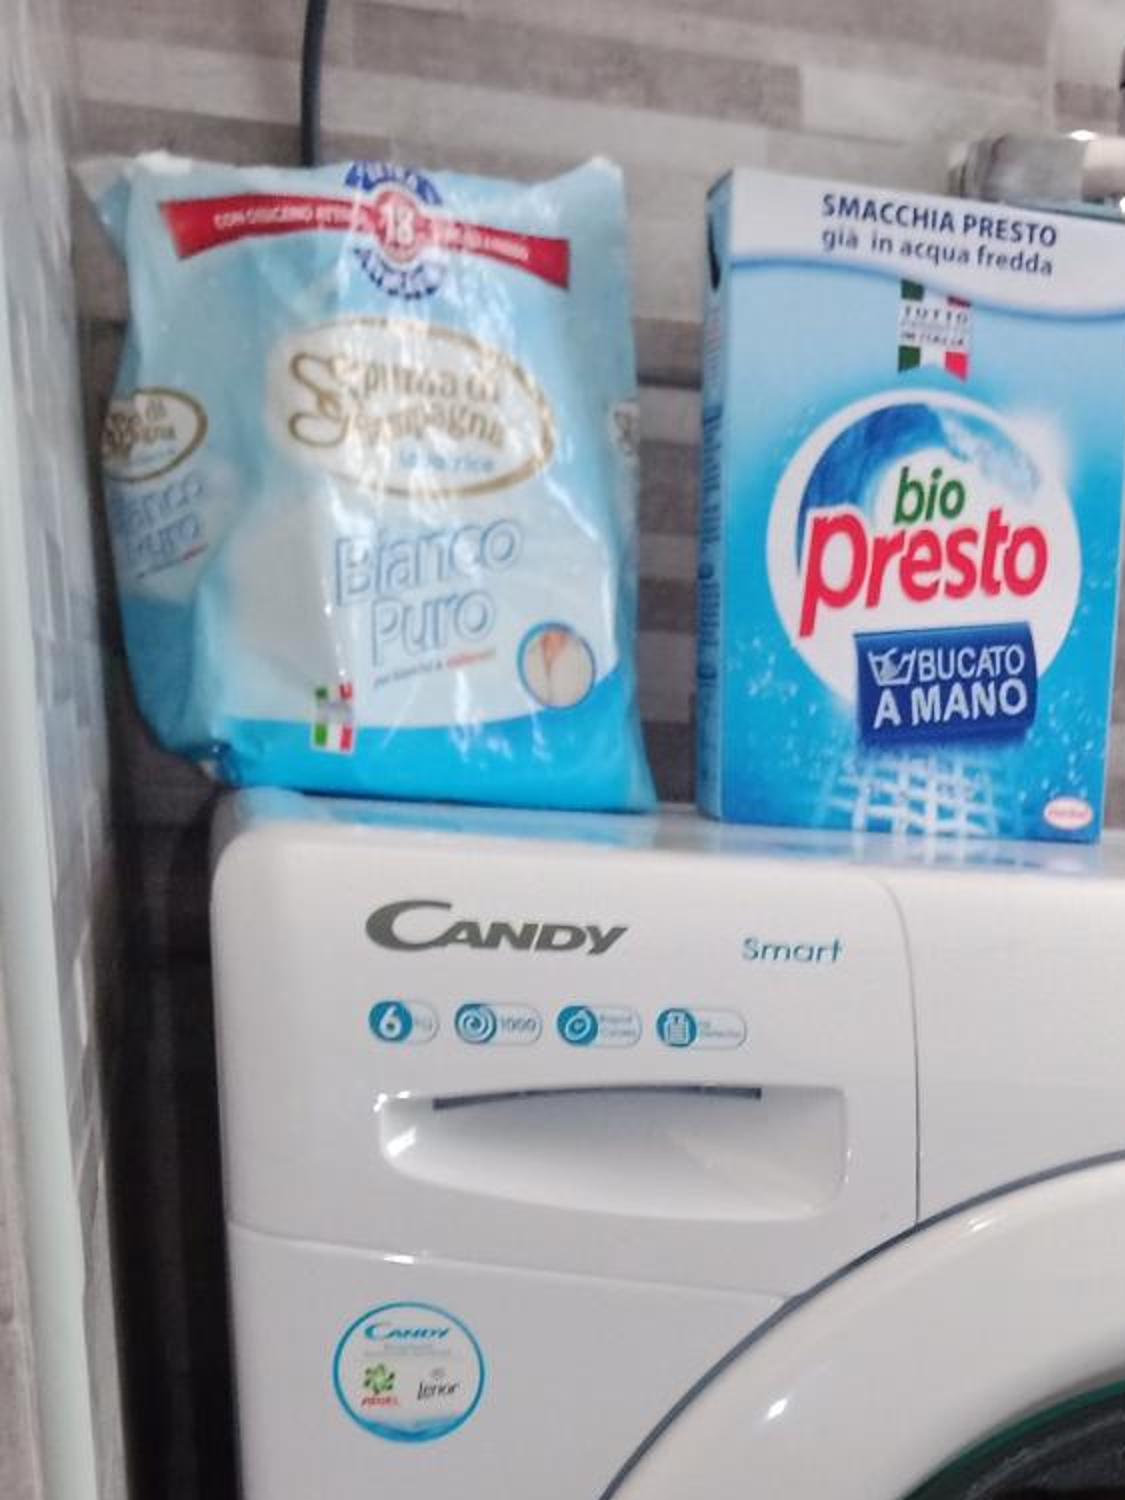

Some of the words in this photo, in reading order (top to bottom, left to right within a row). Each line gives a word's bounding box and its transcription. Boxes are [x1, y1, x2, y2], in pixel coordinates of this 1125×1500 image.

[823, 193, 955, 233] SMACCHIA
[963, 213, 1057, 248] PRESTO
[871, 231, 893, 254] in
[900, 242, 970, 267] acqua
[977, 244, 1053, 276] fredda
[893, 466, 966, 524] bio
[335, 518, 523, 608] Bianco
[371, 590, 495, 668] Puro
[918, 644, 1025, 682] BUCATO
[873, 688, 901, 730] A
[911, 678, 1028, 726] MANO
[365, 899, 630, 956] CANDY
[741, 937, 843, 963] Smart
[380, 1005, 402, 1038] 6
